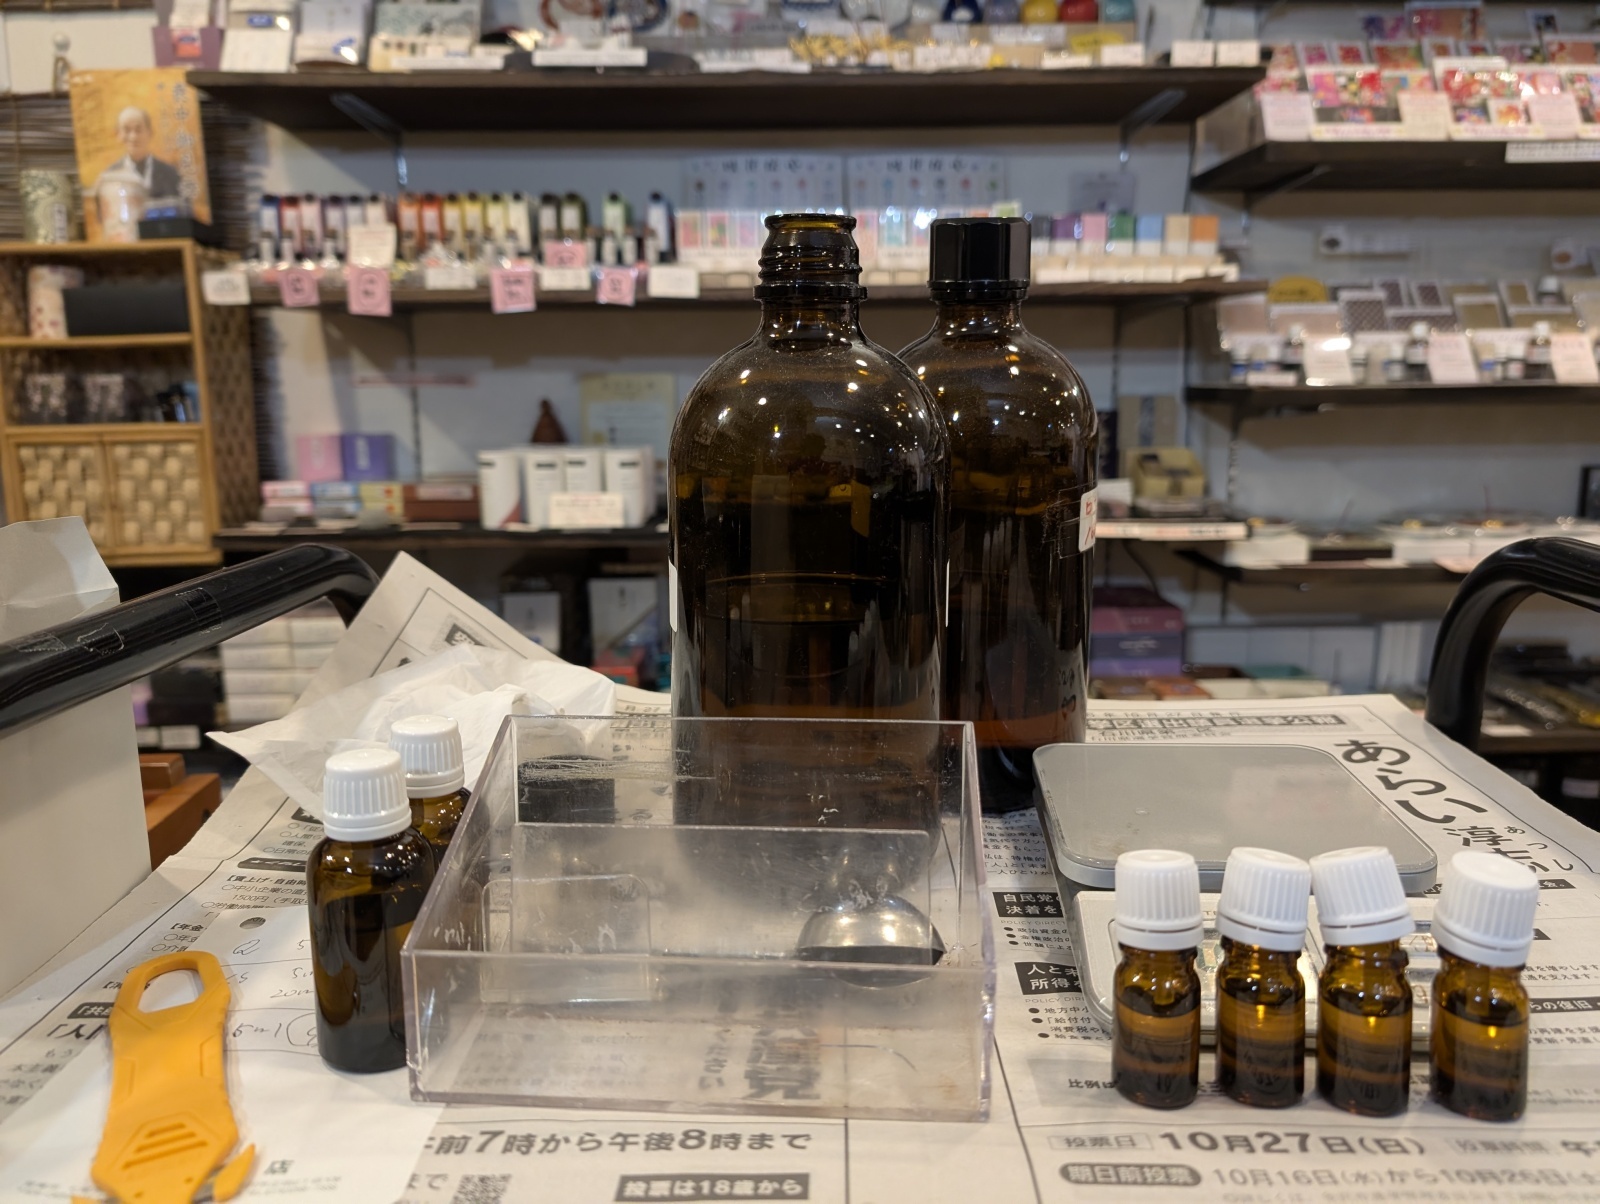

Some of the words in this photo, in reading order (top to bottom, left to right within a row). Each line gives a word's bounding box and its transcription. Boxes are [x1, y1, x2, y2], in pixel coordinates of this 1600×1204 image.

[1067, 1164, 1195, 1185] 期日前投票
[622, 1178, 804, 1199] 投票は18歳から
